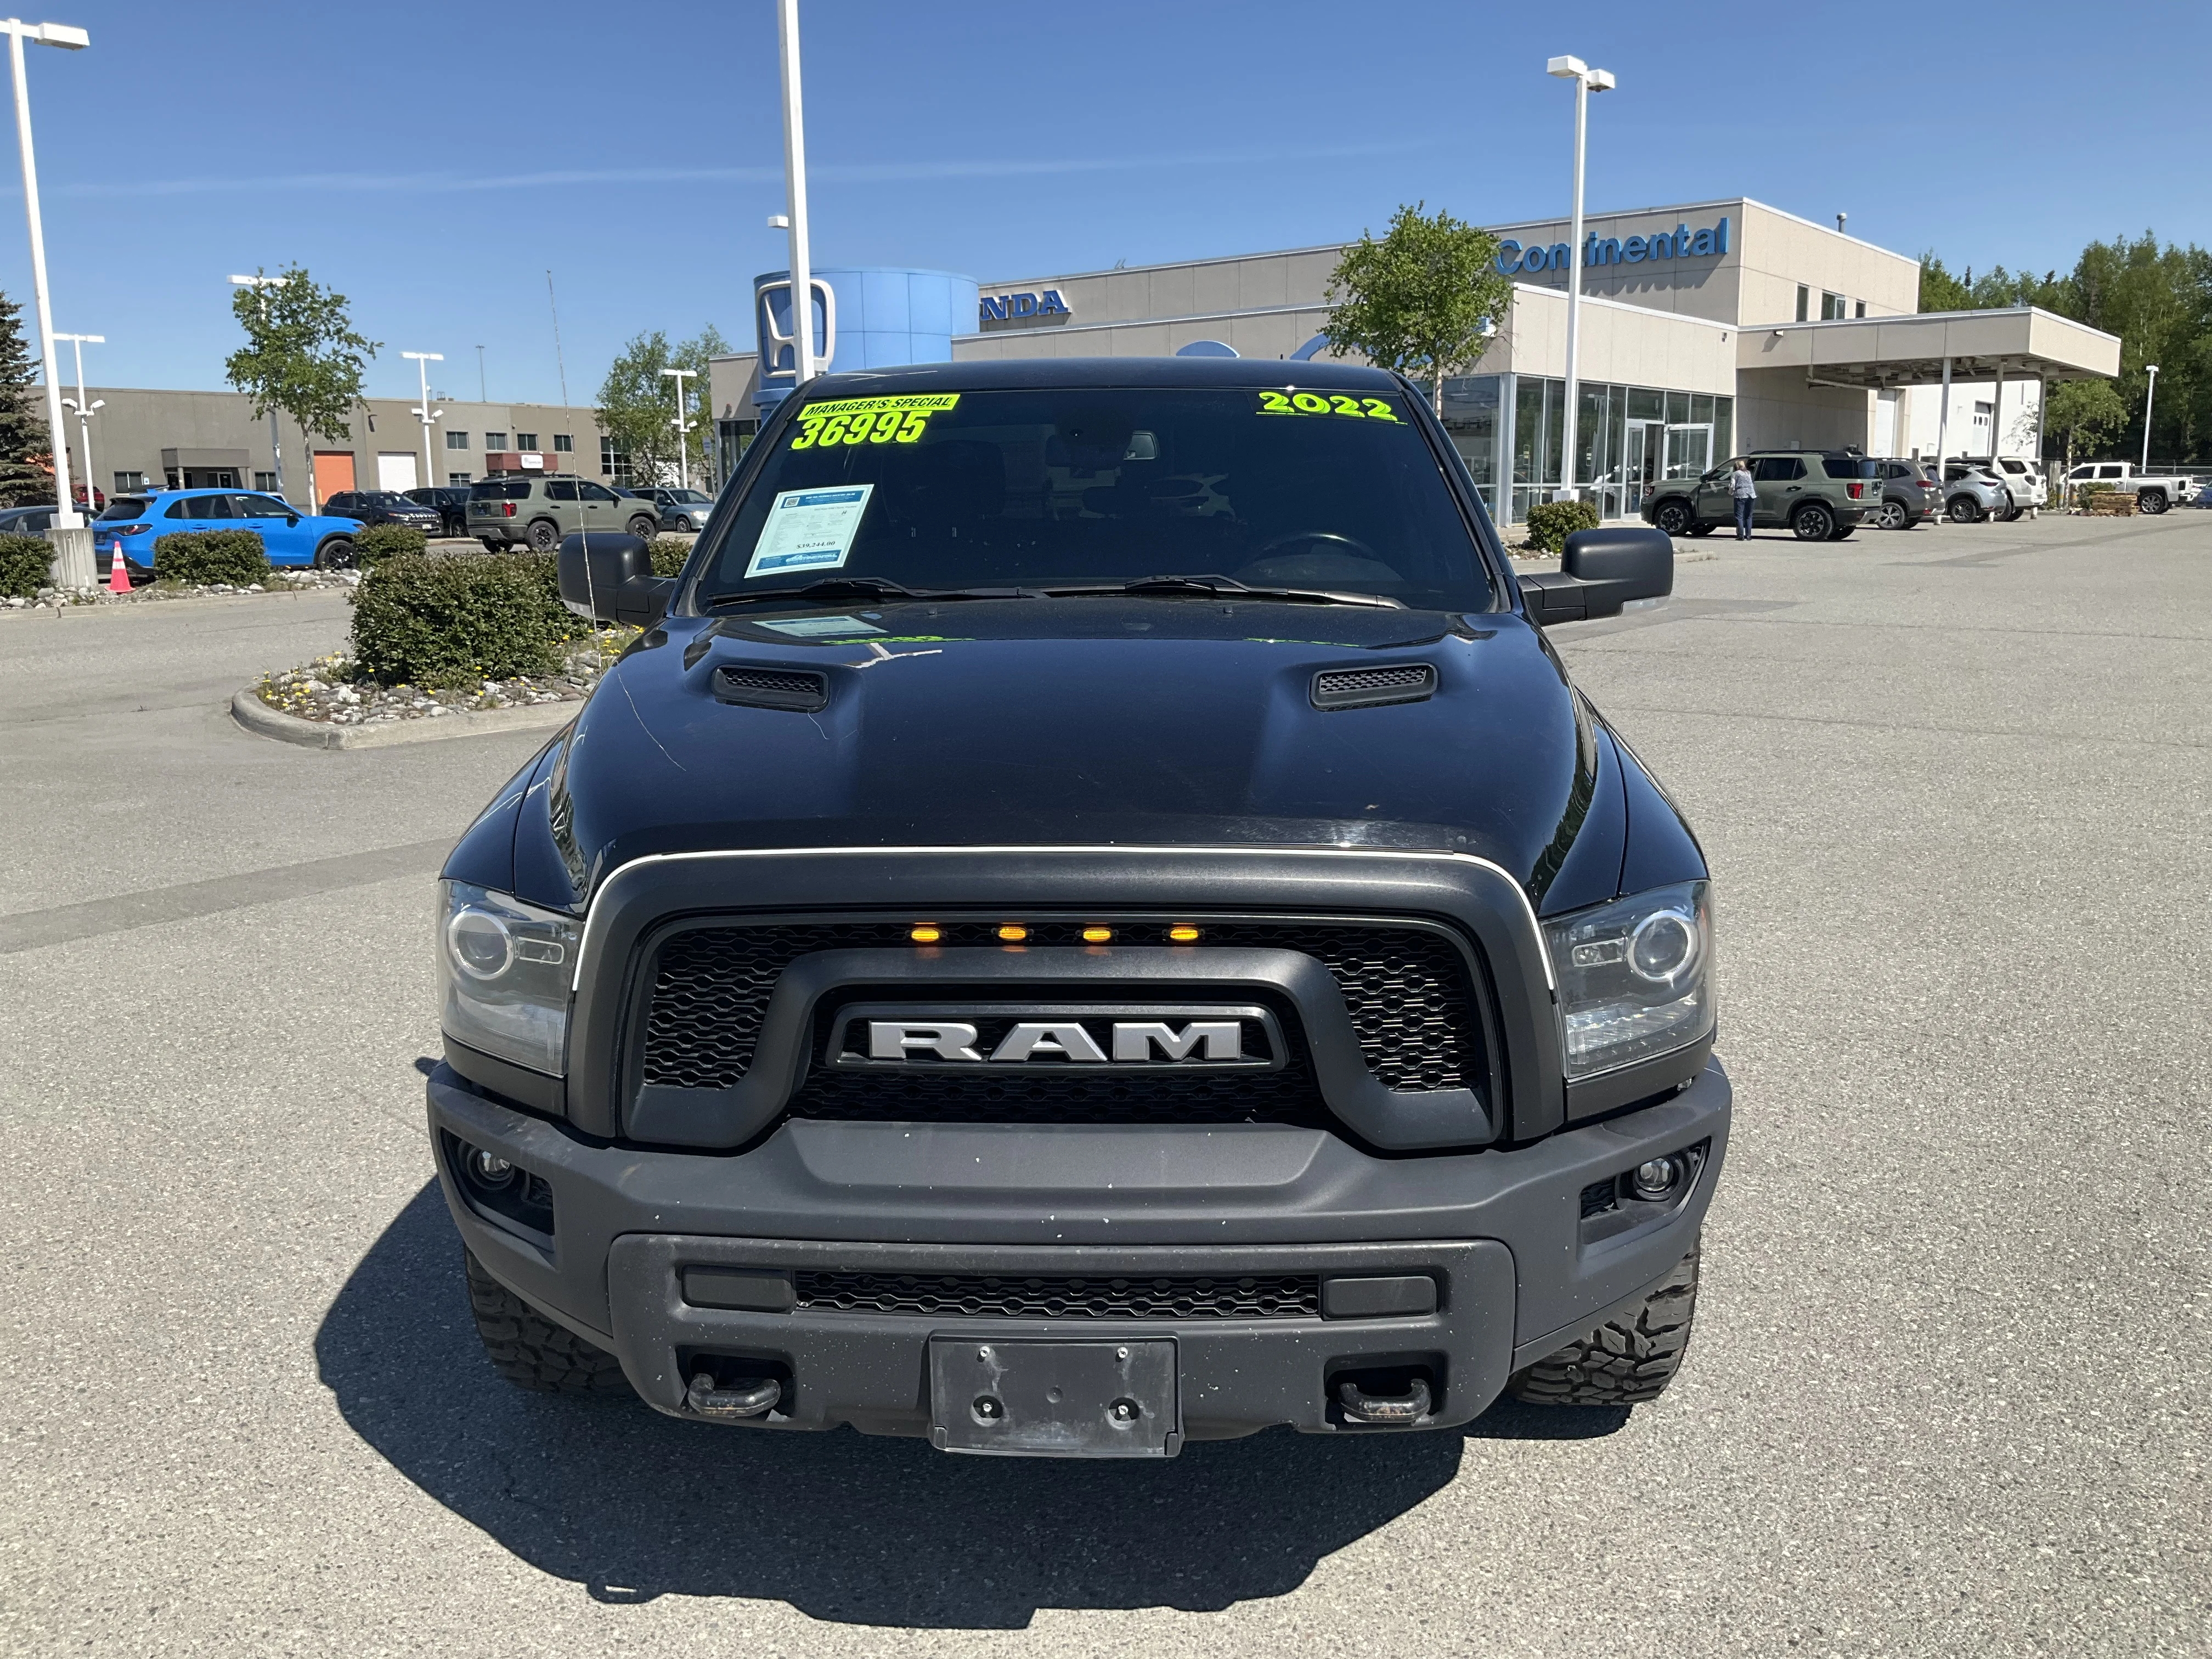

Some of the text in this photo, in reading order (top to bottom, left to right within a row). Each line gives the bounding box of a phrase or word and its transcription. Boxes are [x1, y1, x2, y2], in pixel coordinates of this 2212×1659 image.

[1494, 217, 1729, 274] Coninental
[979, 290, 1071, 321] NDA
[805, 397, 952, 416] MANAGER'S SPECIAL
[1259, 392, 1398, 421] 2022
[791, 410, 933, 449] 36995
[868, 1020, 1242, 1062] RAM
